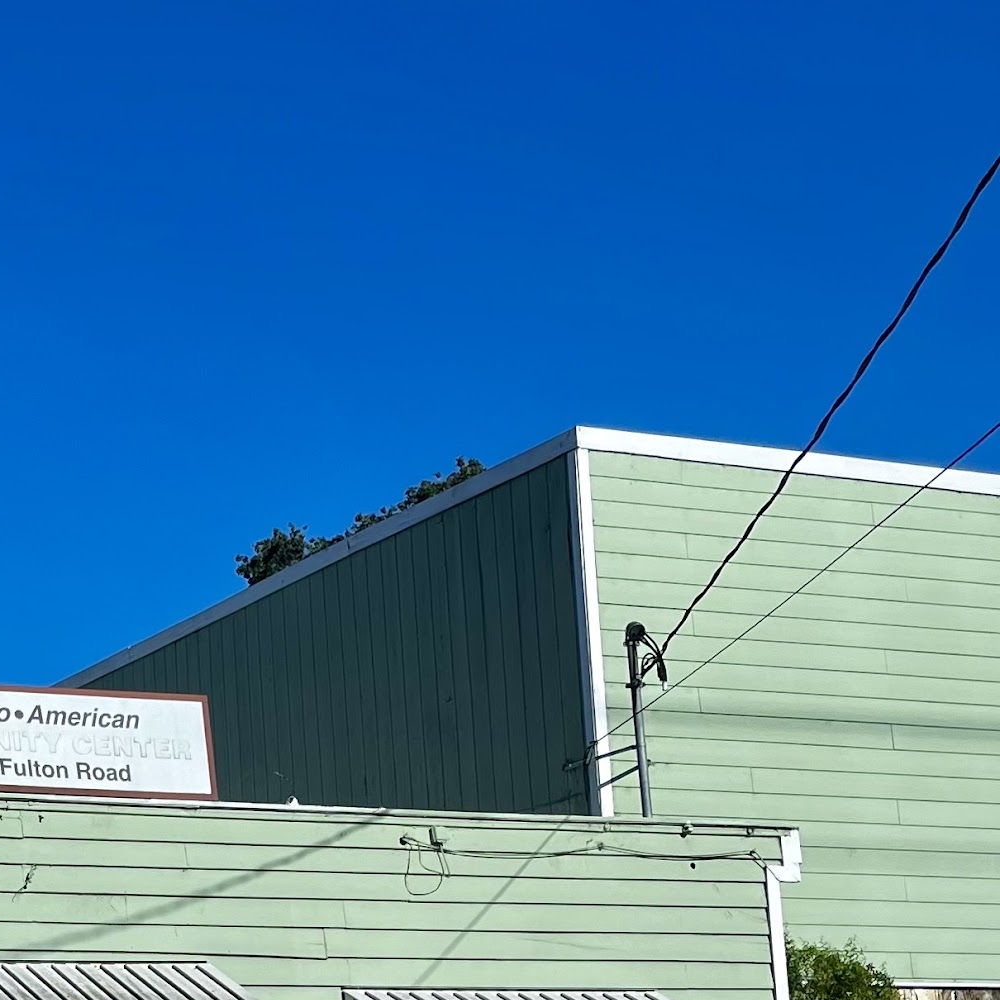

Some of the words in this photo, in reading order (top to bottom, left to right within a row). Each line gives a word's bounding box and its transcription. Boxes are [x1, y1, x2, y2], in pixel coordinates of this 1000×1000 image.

[72, 732, 192, 760] CENTER
[0, 758, 69, 779] Fulton
[76, 762, 132, 782] Road
